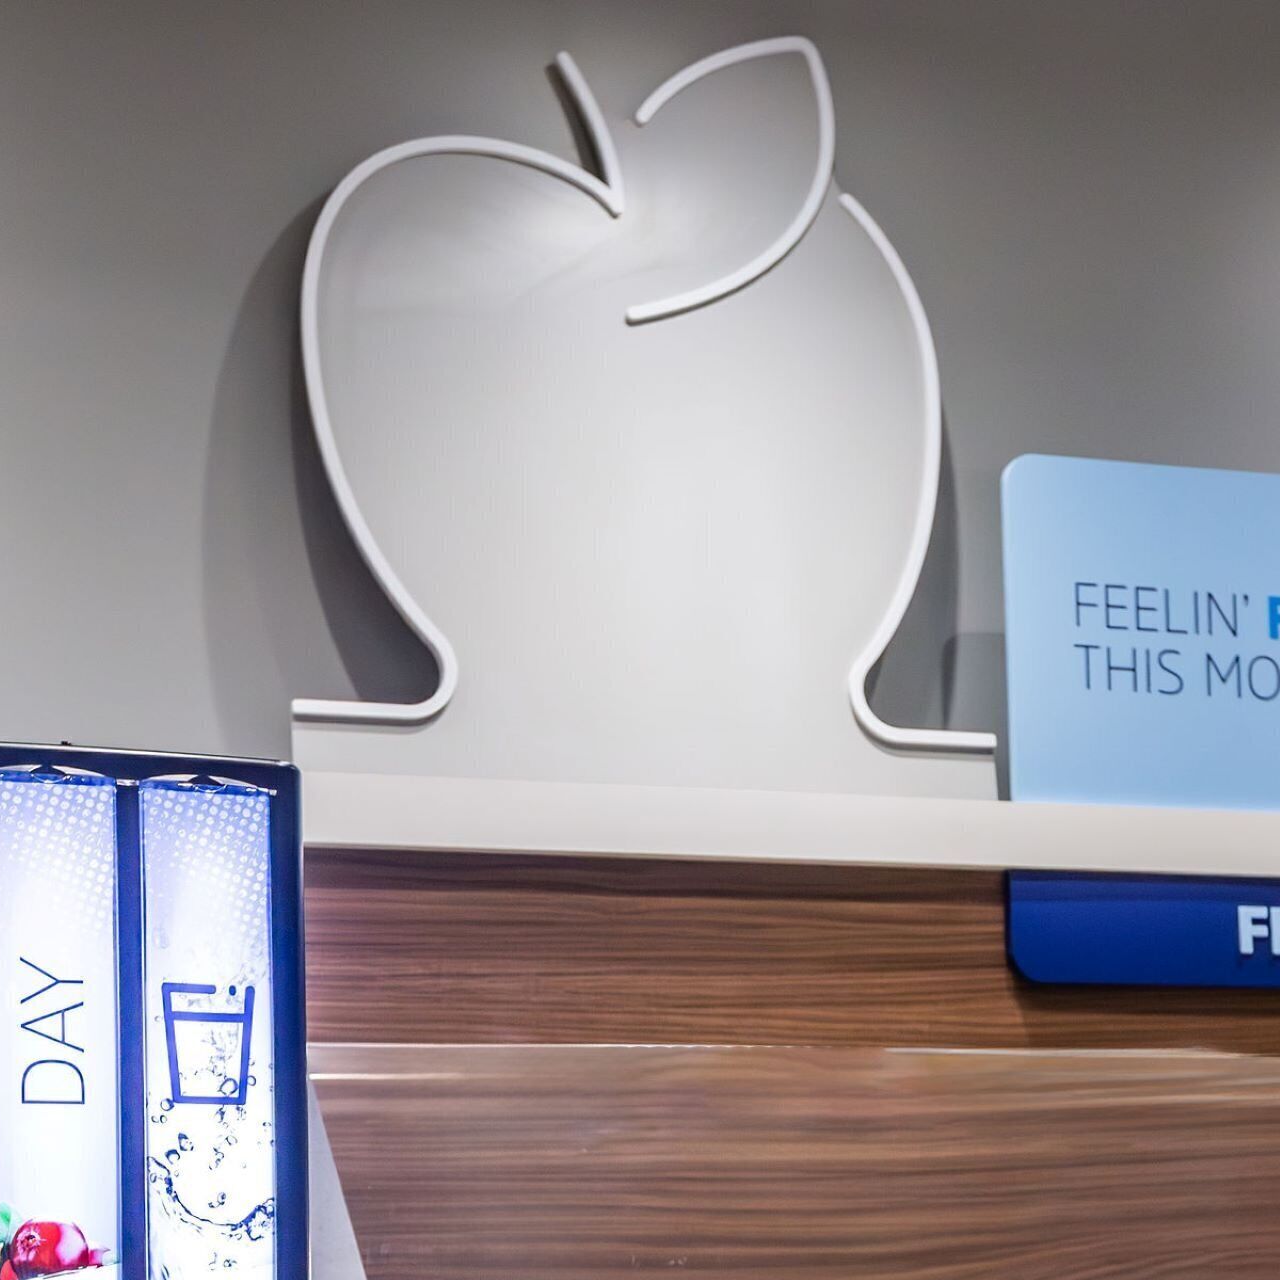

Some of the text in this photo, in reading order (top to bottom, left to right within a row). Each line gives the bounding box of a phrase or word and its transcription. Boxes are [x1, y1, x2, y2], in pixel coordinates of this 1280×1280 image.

[1073, 581, 1250, 638] FEELIN'
[1073, 643, 1186, 696] THIS
[19, 956, 86, 1106] DAY
